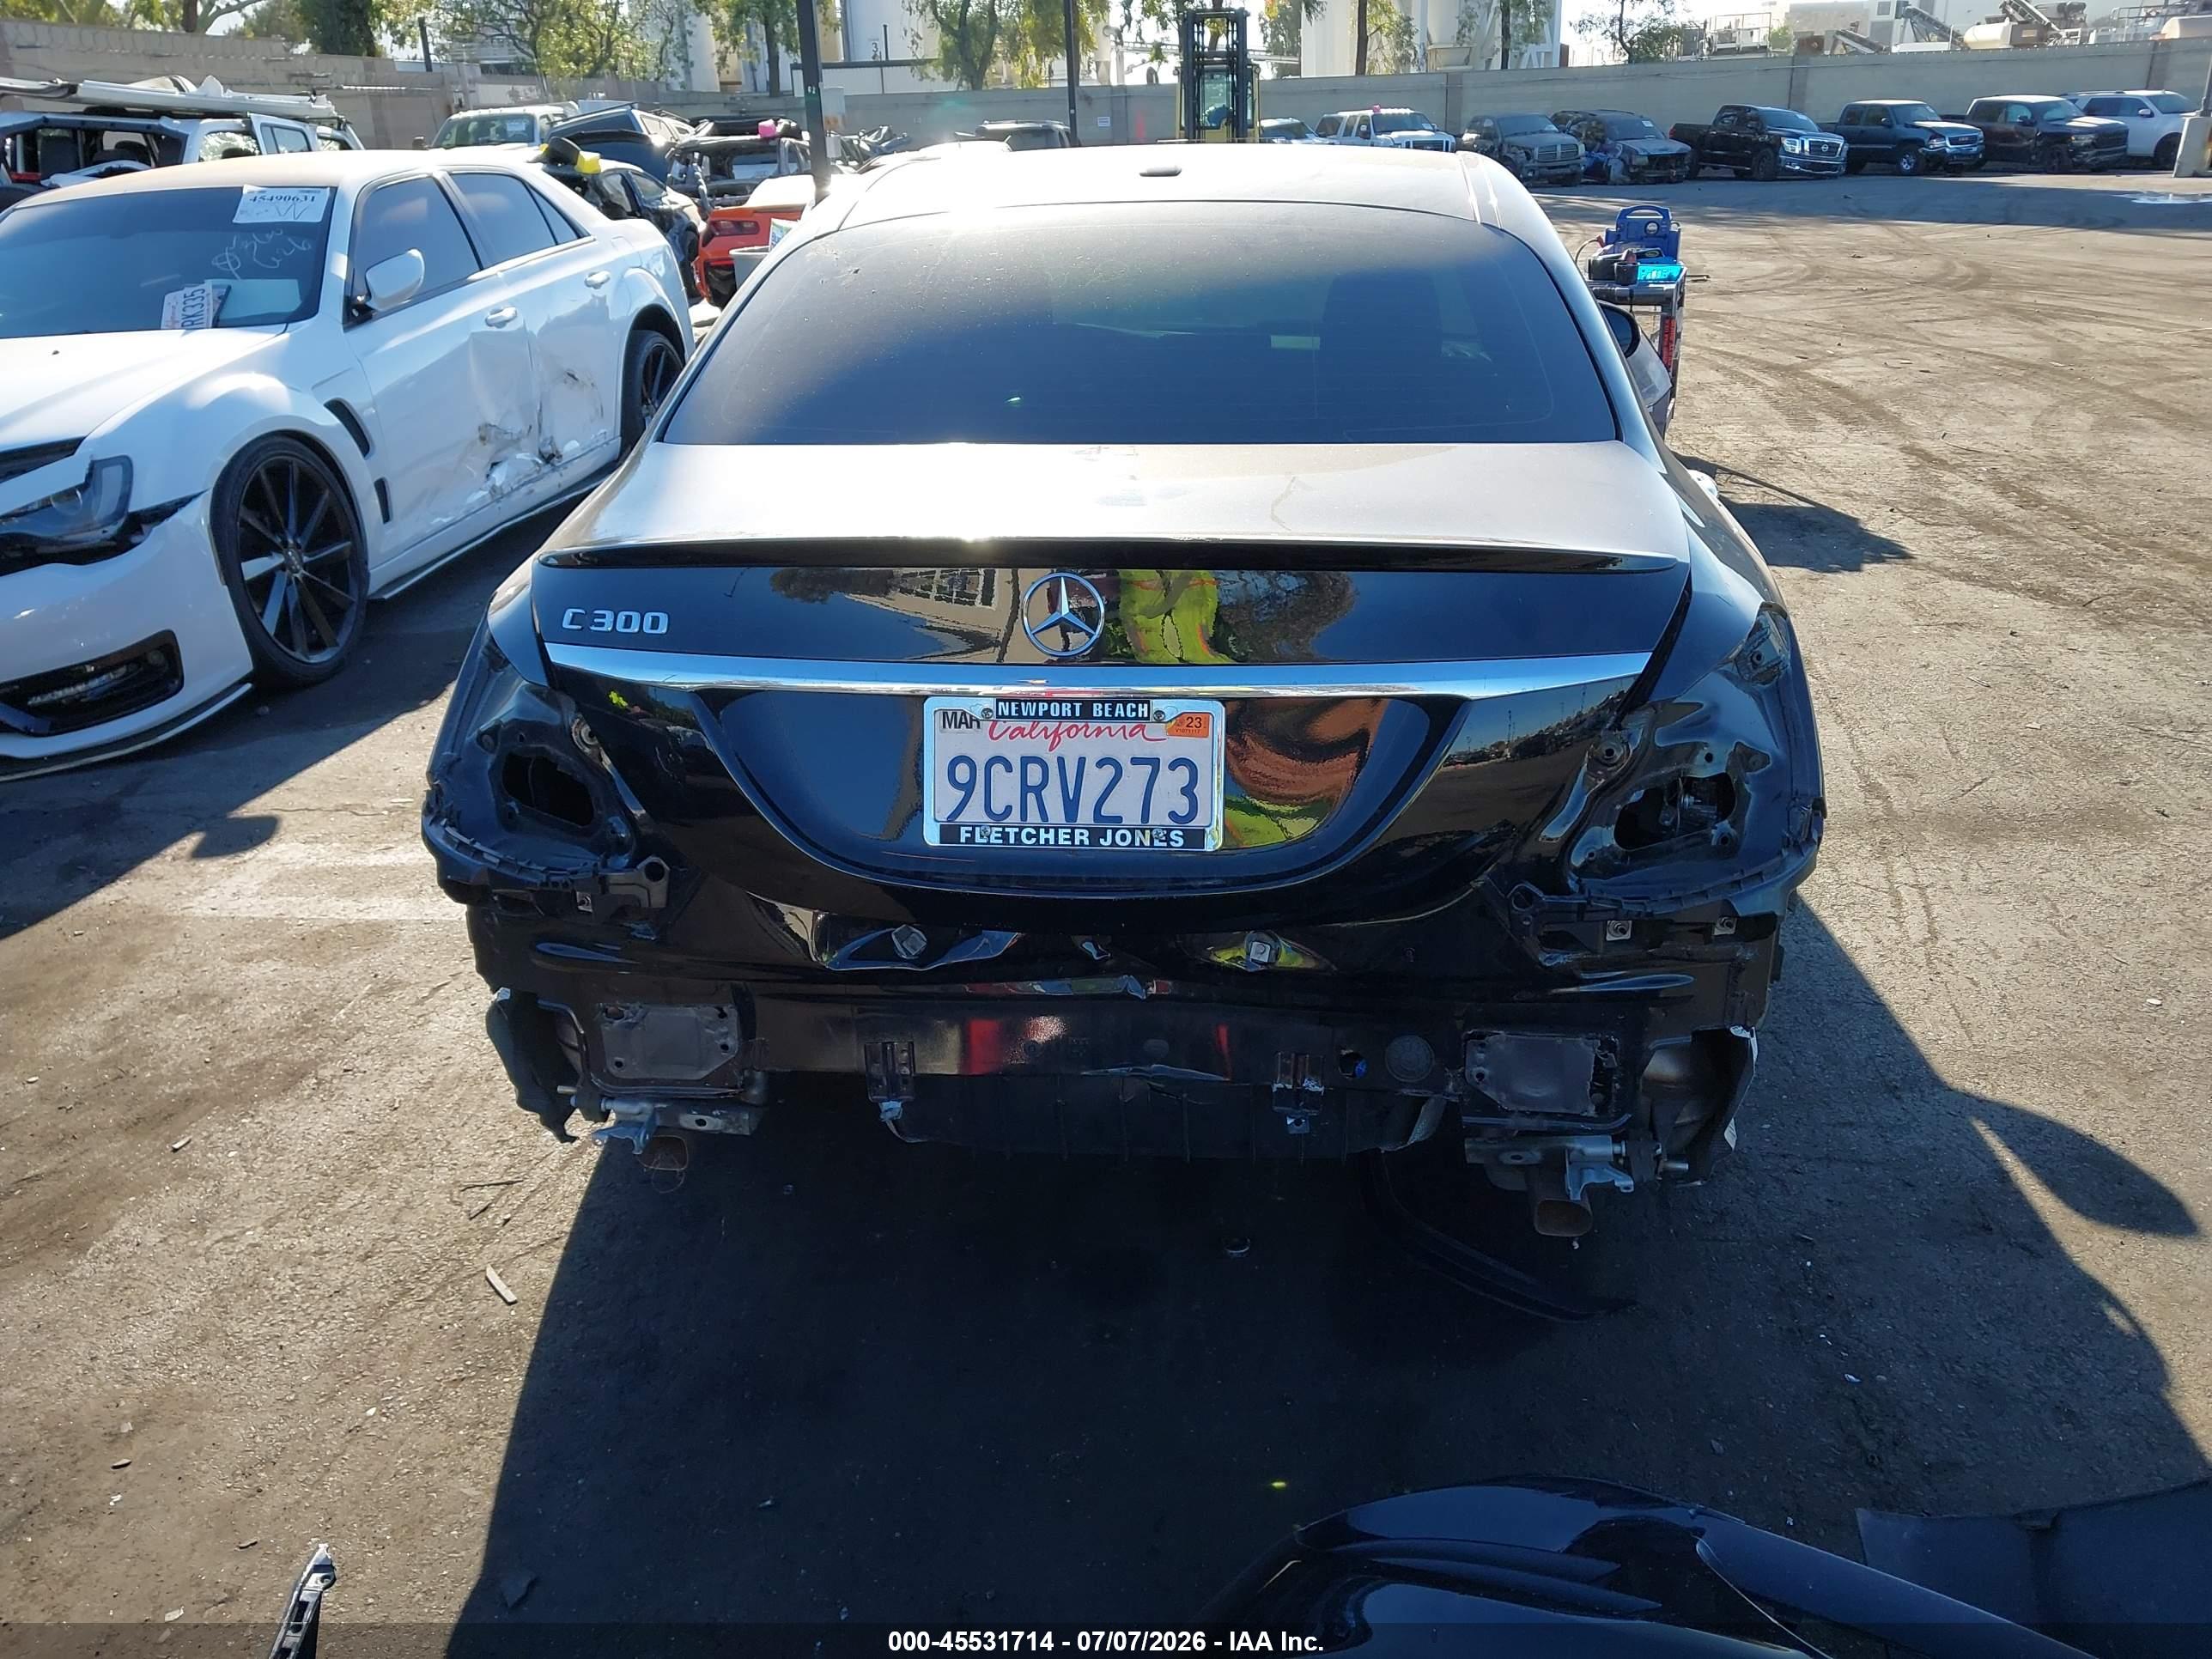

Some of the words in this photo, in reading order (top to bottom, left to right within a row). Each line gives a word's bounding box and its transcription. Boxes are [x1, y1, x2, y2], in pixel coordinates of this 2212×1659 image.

[562, 608, 586, 629] C
[590, 610, 669, 635] 300
[998, 701, 1082, 718] NEWPORT
[1092, 701, 1149, 719] BEACH
[1186, 716, 1202, 728] 23
[988, 720, 1167, 752] California
[946, 755, 1199, 824] 9CRV273
[959, 826, 1090, 846] FLETCHER
[1099, 829, 1184, 847] JONES
